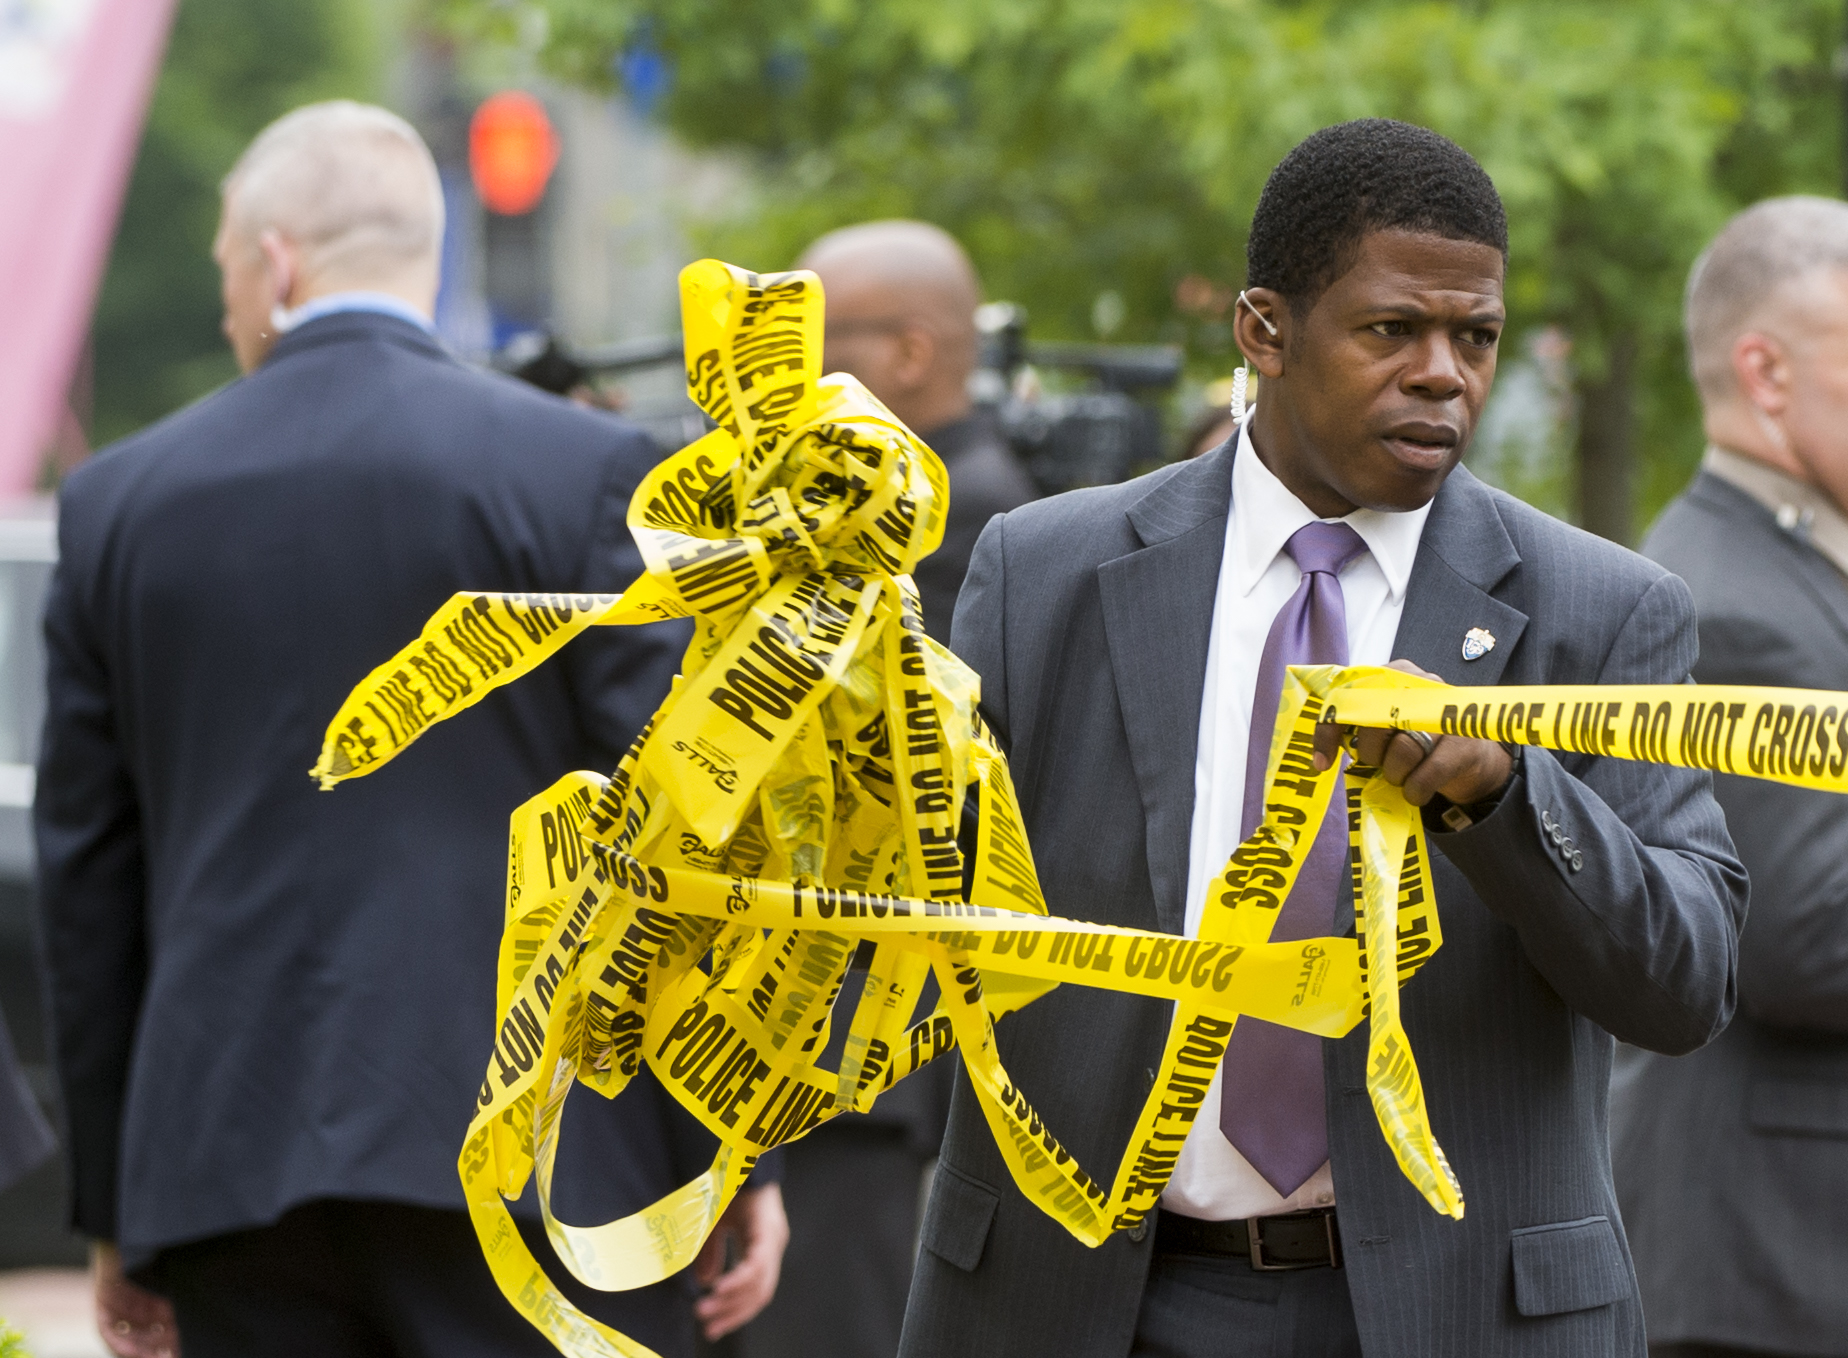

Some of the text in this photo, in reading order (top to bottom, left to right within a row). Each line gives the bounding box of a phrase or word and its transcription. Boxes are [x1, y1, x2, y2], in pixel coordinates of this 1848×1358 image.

[364, 668, 437, 749] LINE
[408, 641, 473, 705] DO
[443, 594, 525, 681] NOT
[903, 689, 939, 756] NOT
[1554, 702, 1622, 757] LINE
[1629, 701, 1672, 765] DO
[1679, 702, 1746, 775] NOT
[670, 741, 740, 795] GALLS
[911, 768, 949, 815] DO
[726, 875, 751, 915] GAL
[599, 907, 682, 989] OLICE
[499, 997, 546, 1088] NOT
[655, 1000, 772, 1130] POLICE
[743, 1075, 836, 1148] LINE
